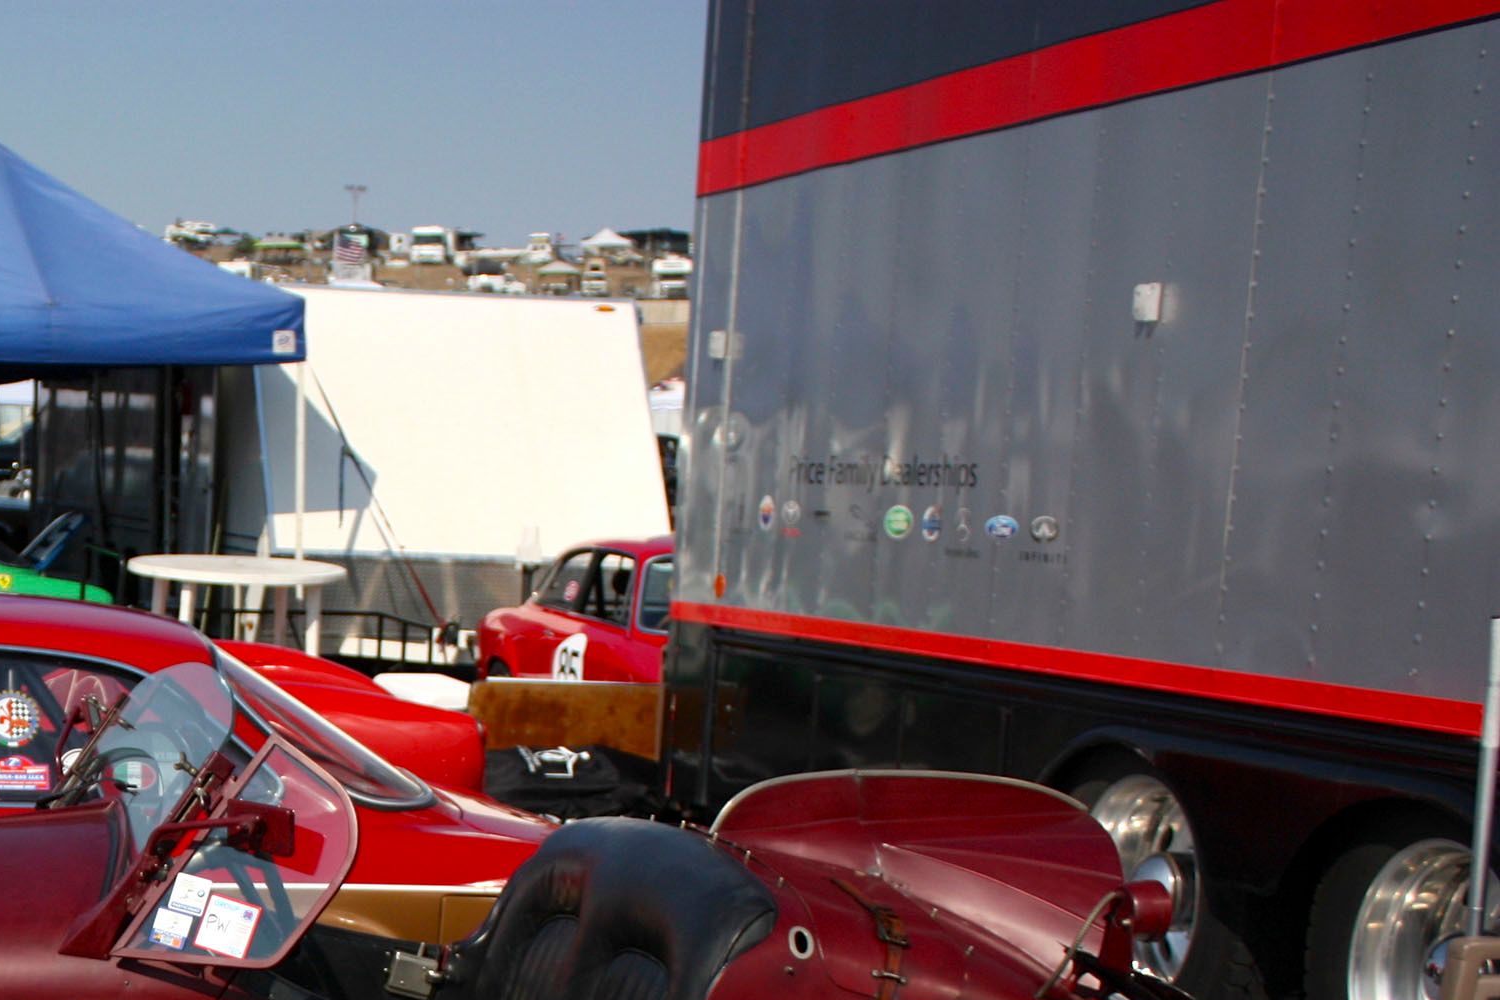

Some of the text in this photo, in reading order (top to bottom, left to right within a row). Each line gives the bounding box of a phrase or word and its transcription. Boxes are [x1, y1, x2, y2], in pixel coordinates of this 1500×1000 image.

[789, 454, 977, 493] Price Family Dealerships
